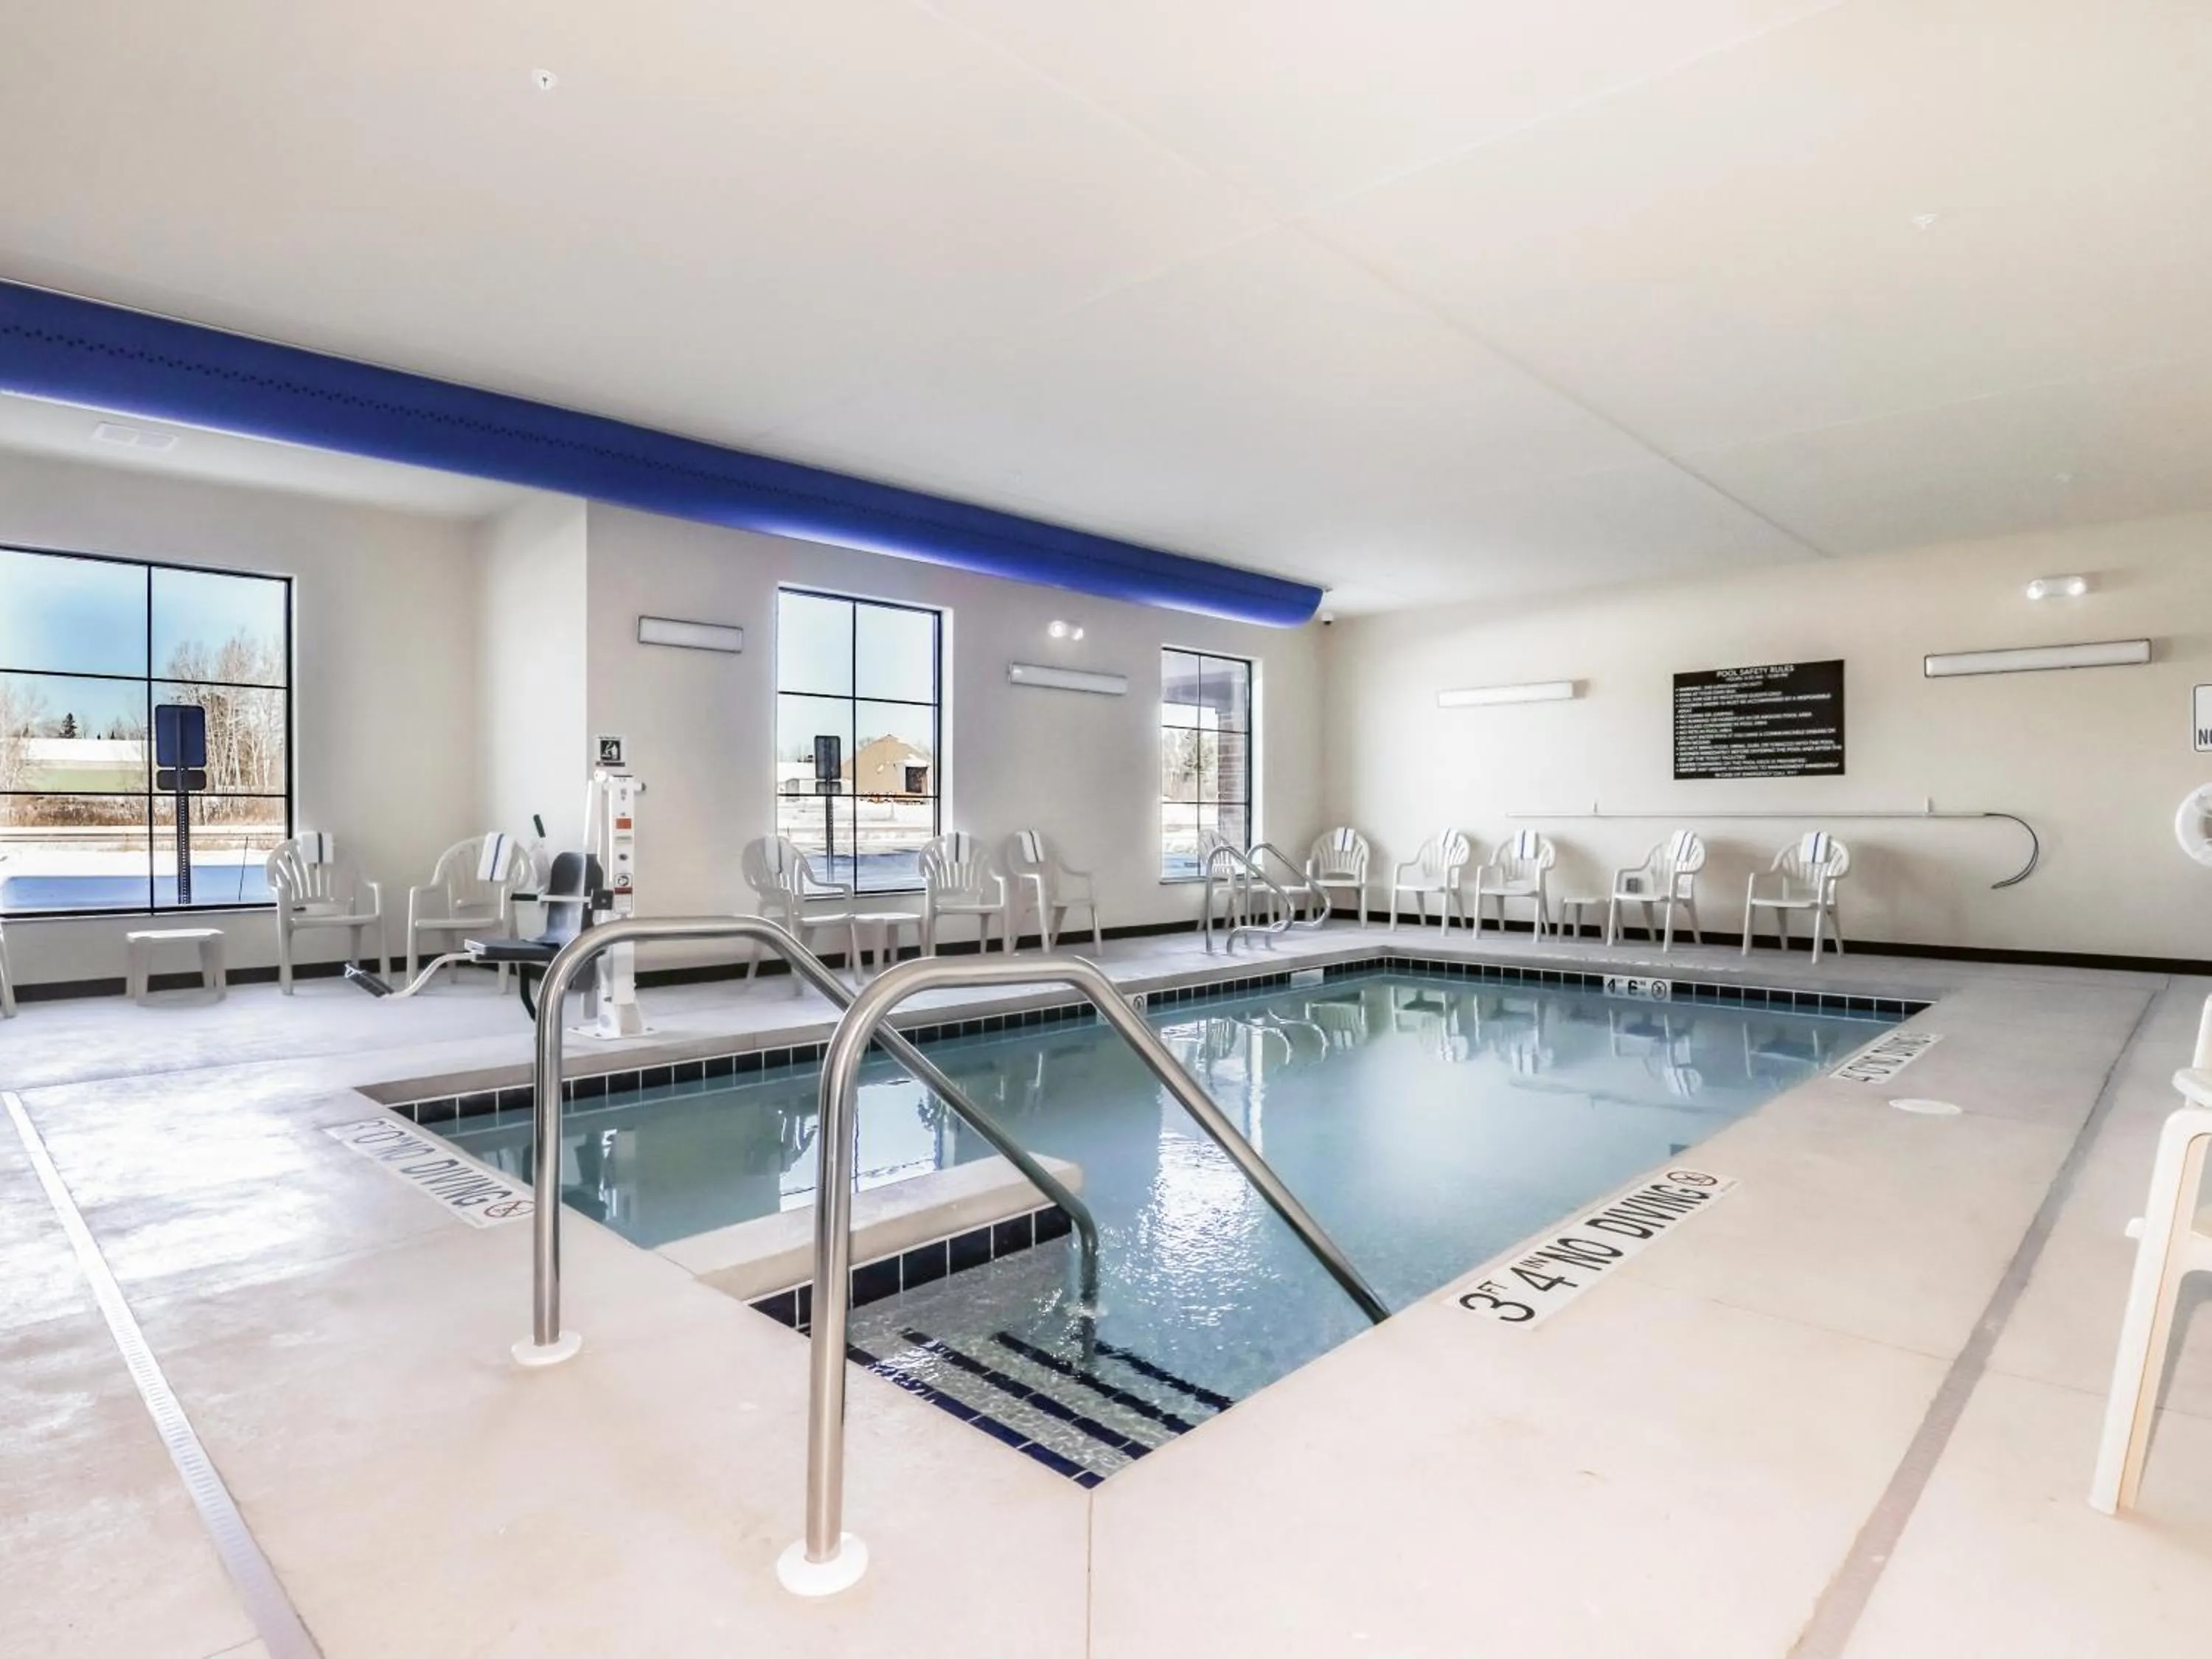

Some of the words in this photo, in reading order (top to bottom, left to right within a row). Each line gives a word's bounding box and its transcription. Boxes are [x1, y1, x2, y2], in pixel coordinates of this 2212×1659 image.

[1717, 669, 1737, 678] POOL
[1740, 667, 1768, 676] SAFETY
[1770, 664, 1794, 673] RULES
[400, 1158, 513, 1206] DIVING
[1534, 1237, 1624, 1271] NO
[1584, 1184, 1711, 1239] DIVING
